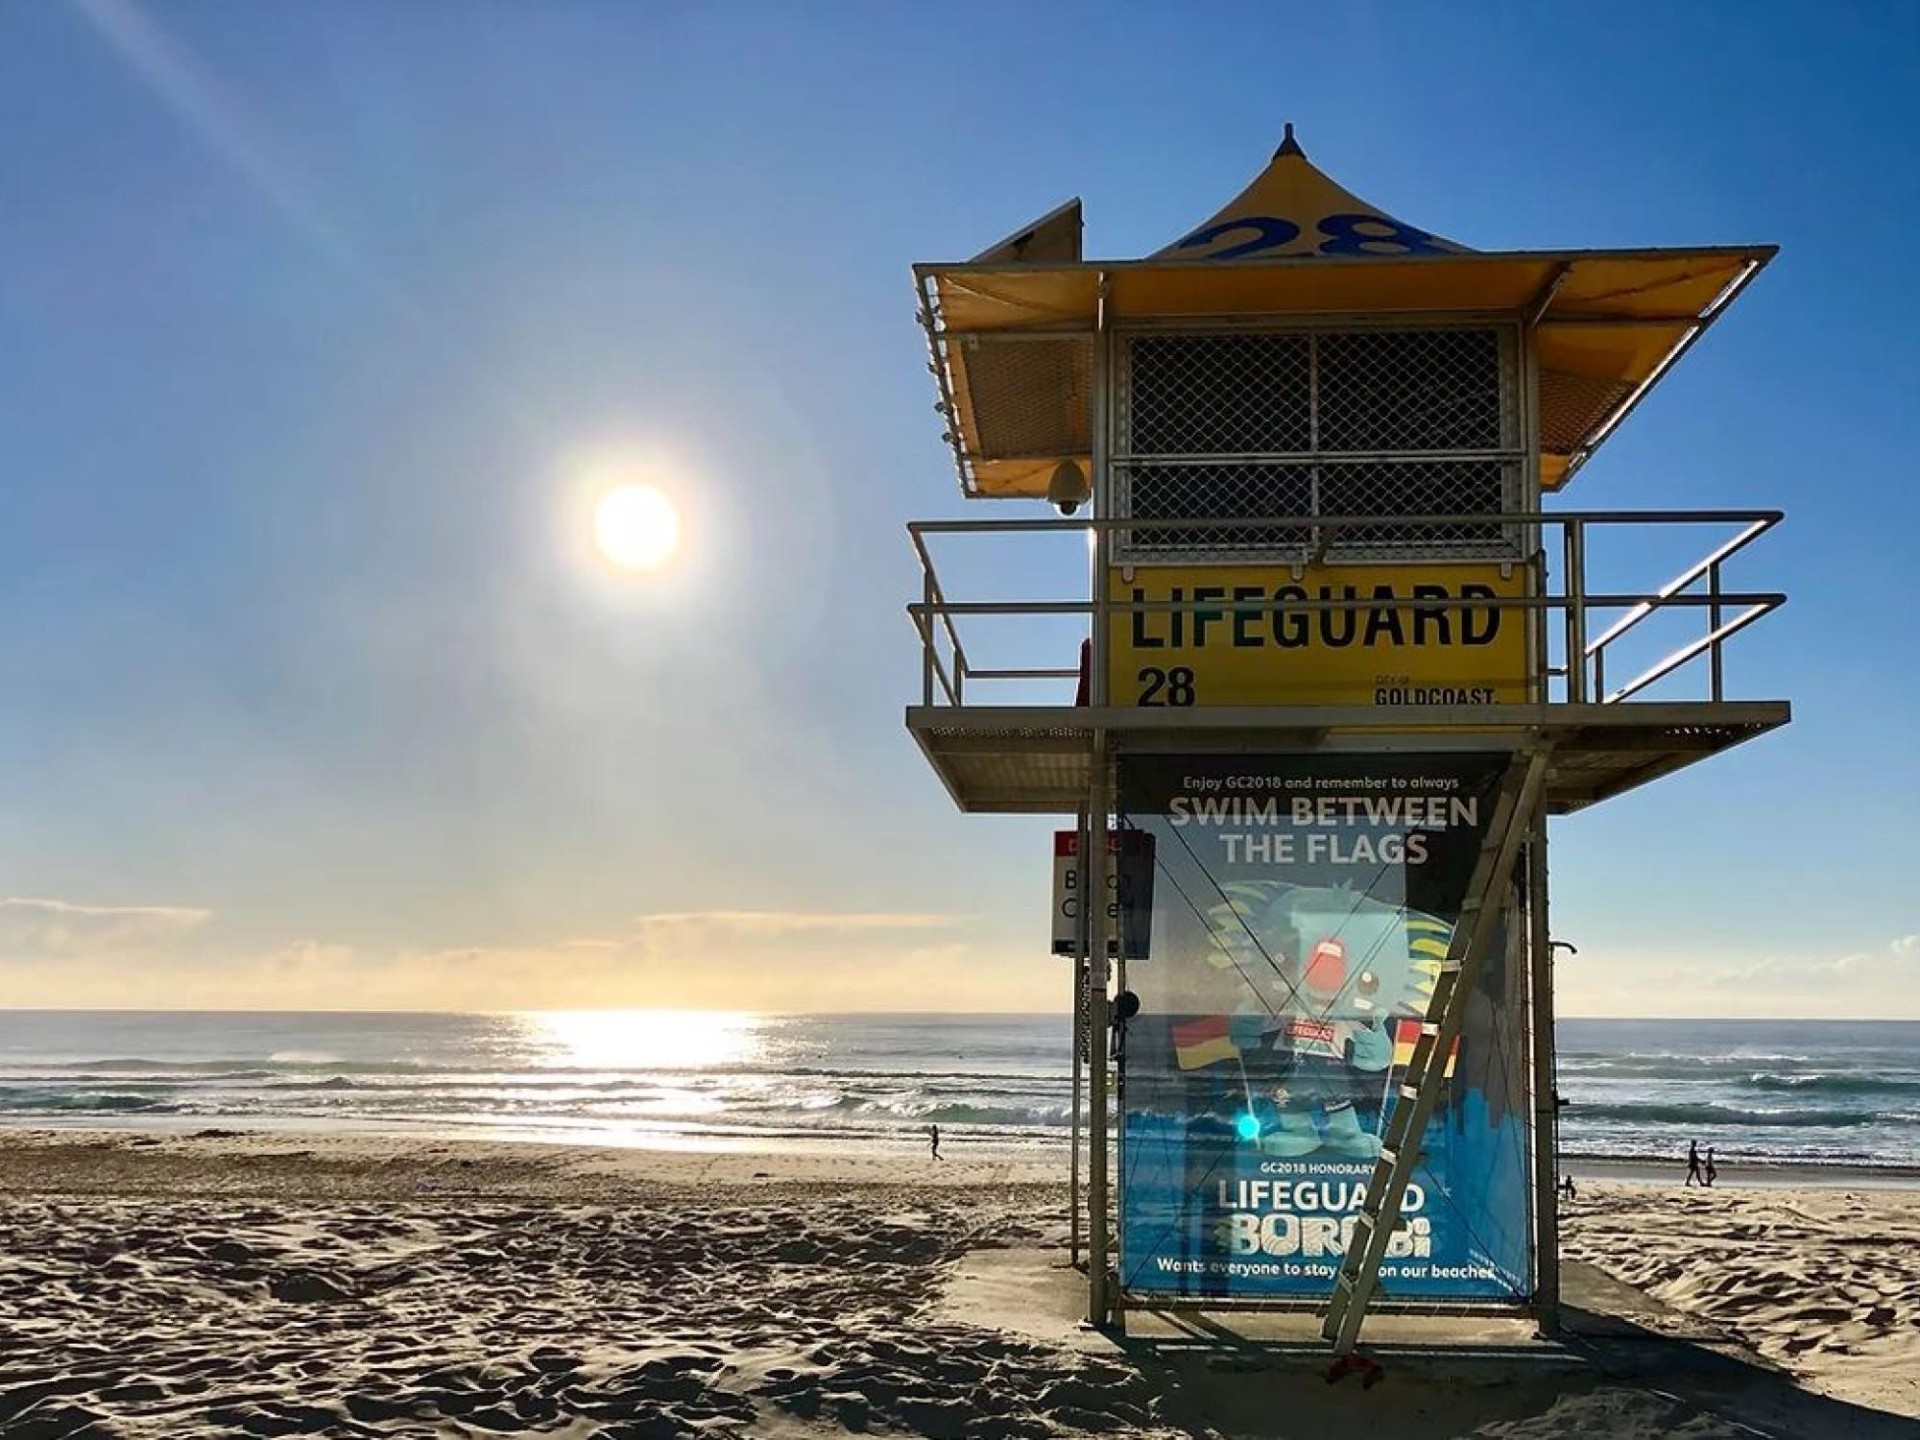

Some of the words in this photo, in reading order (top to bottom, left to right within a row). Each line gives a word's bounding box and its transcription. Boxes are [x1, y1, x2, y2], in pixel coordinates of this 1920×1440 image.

[1178, 213, 1455, 260] 28
[1131, 584, 1501, 648] LIFEGUARD
[1137, 666, 1196, 707] 28
[1183, 775, 1223, 791] Enjoy
[1226, 776, 1282, 789] GC2018
[1285, 776, 1312, 789] and
[1315, 776, 1388, 789] remember
[1391, 777, 1407, 789] to
[1410, 776, 1459, 790] always
[1168, 797, 1277, 827] SWIM
[1292, 797, 1478, 827] BETWEEN
[1219, 834, 1295, 864] THE
[1307, 834, 1428, 864] FLAGS
[1260, 1162, 1307, 1174] GC2018
[1218, 1180, 1425, 1212] LIFEGUAD
[1157, 1258, 1206, 1273] Wants
[1210, 1263, 1280, 1278] everyone
[1284, 1264, 1301, 1276] to
[1304, 1264, 1337, 1278] stay
[1378, 1267, 1397, 1278] on
[1401, 1267, 1427, 1278] our
